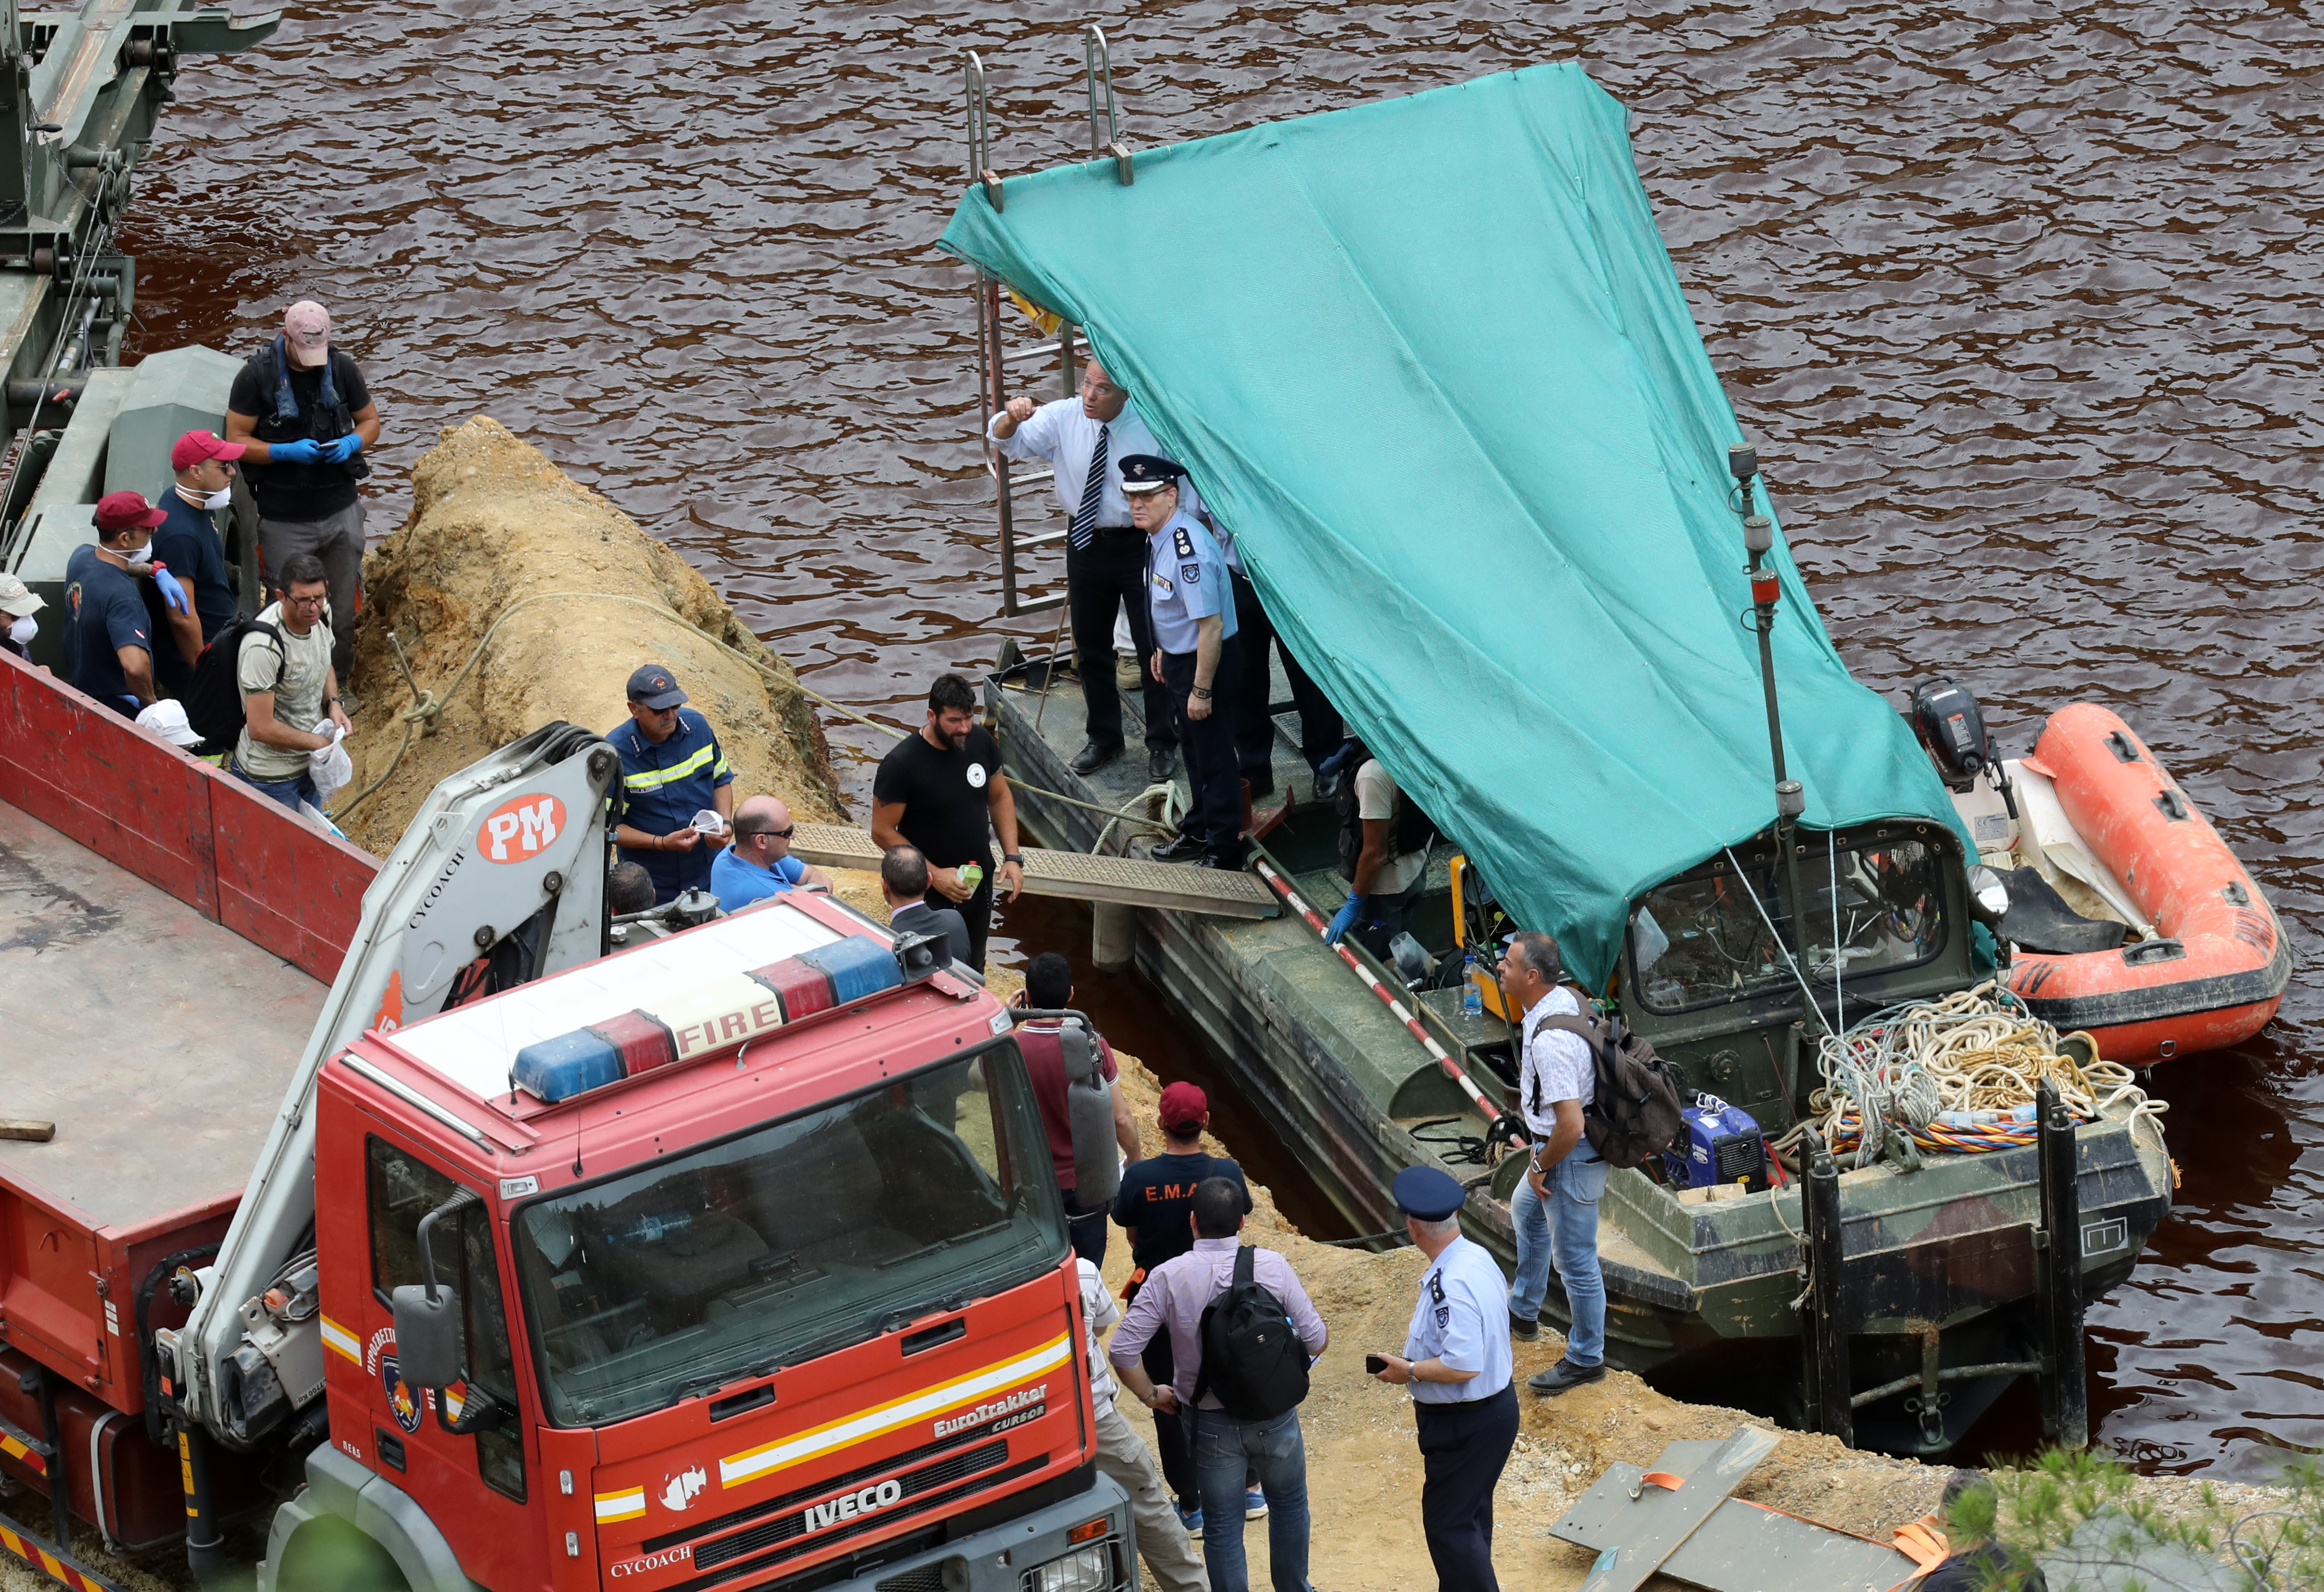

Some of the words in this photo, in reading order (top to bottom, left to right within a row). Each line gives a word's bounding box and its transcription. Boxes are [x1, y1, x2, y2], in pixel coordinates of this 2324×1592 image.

[487, 798, 556, 860] PM
[409, 851, 465, 929] CYCOACH
[676, 999, 780, 1054] FIRE
[367, 1327, 396, 1376] ΠΥΡΟΣΒΕΣΤΙ
[933, 1384, 1048, 1438] EuroTrakker
[990, 1403, 1046, 1433] CURSOR
[805, 1479, 902, 1534] IVECO
[610, 1545, 691, 1579] CYCOACH
